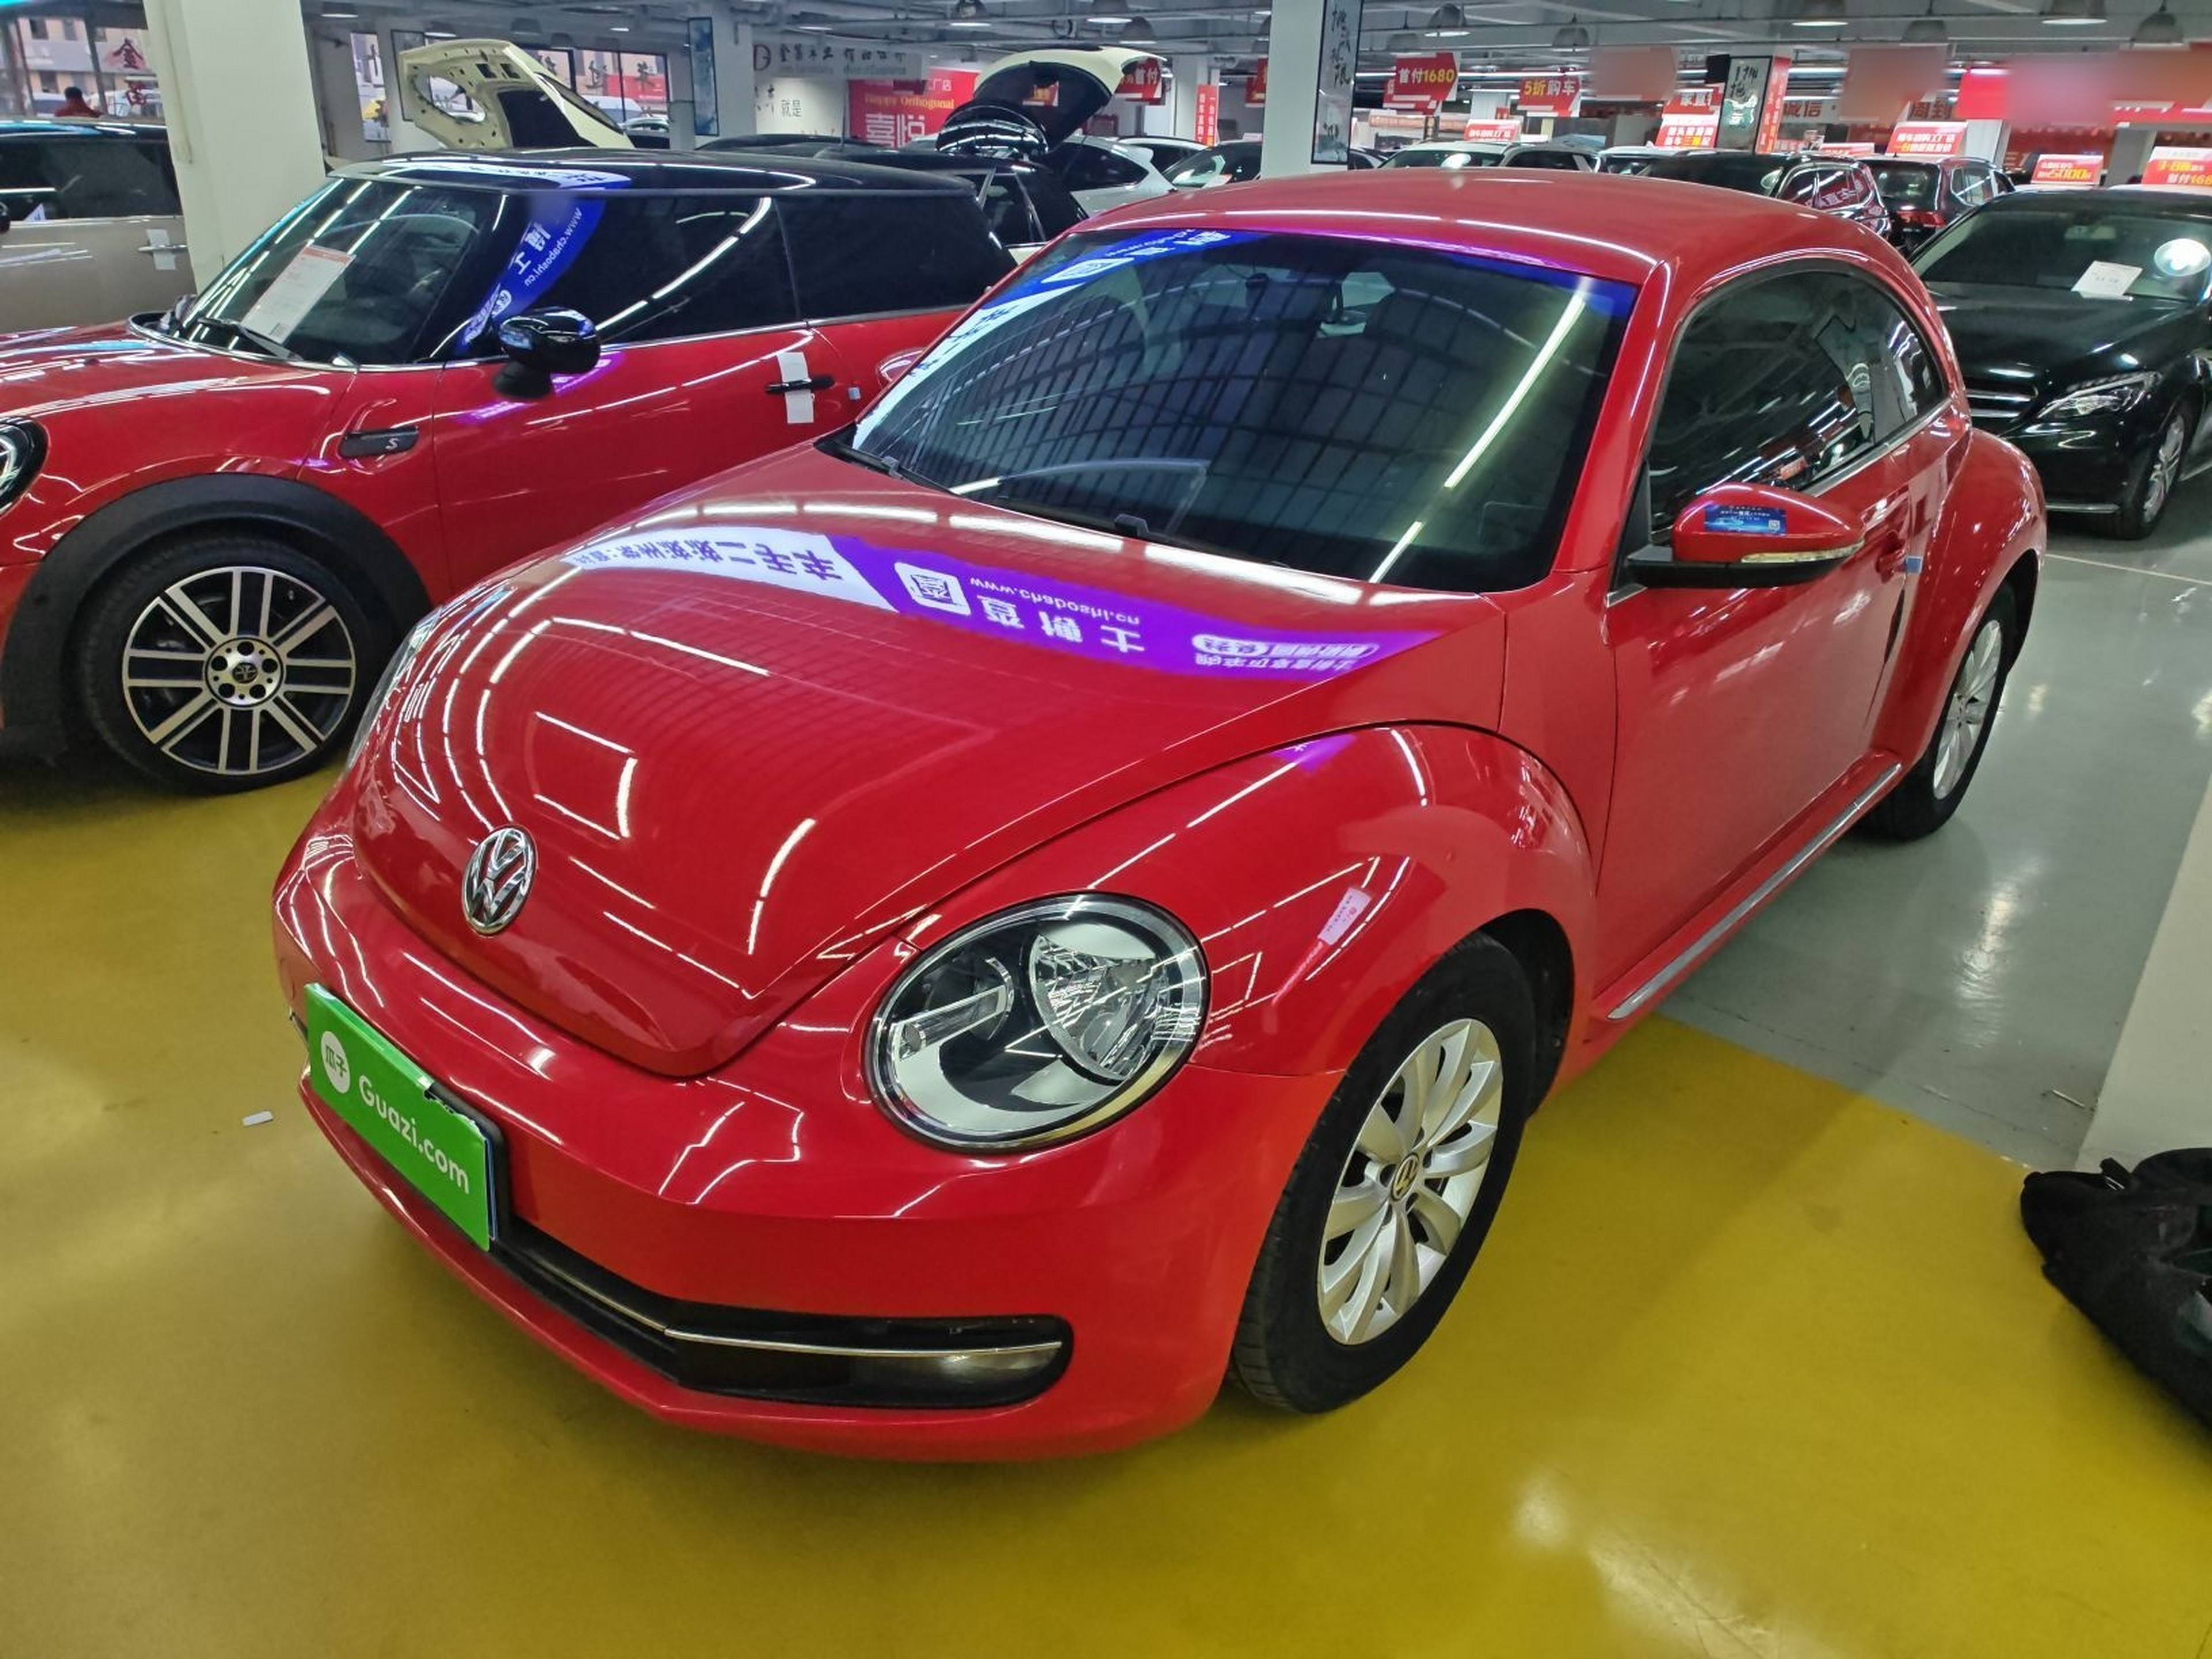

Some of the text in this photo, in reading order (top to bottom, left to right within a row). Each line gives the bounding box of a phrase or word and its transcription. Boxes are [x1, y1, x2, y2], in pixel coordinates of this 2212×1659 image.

[1398, 67, 1455, 85] 首付1680
[1524, 79, 1575, 97] 5折购车
[385, 438, 399, 450] S
[325, 1044, 347, 1078] 瓜子
[359, 1075, 469, 1194] Guazi.com
